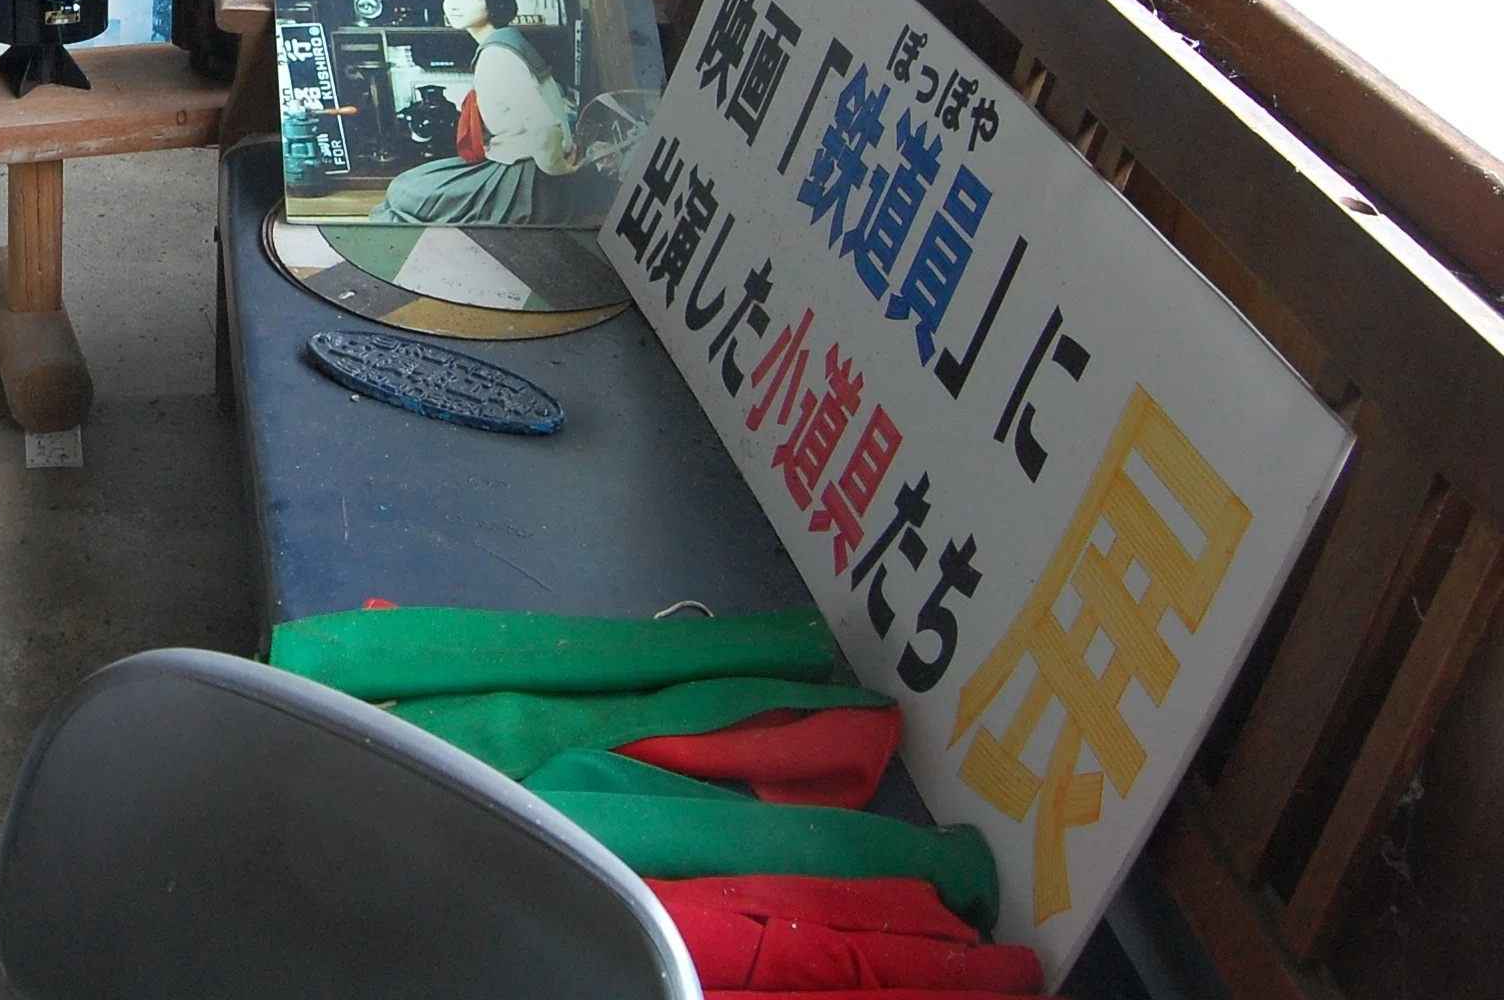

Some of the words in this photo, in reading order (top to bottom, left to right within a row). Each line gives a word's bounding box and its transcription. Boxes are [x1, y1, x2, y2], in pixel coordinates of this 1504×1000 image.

[310, 37, 334, 101] KUSHIRO
[886, 22, 1000, 153] ぽっぽや
[332, 140, 346, 166] FOR
[614, 136, 984, 695] 出演した小道具たち
[945, 381, 1255, 928] 展
